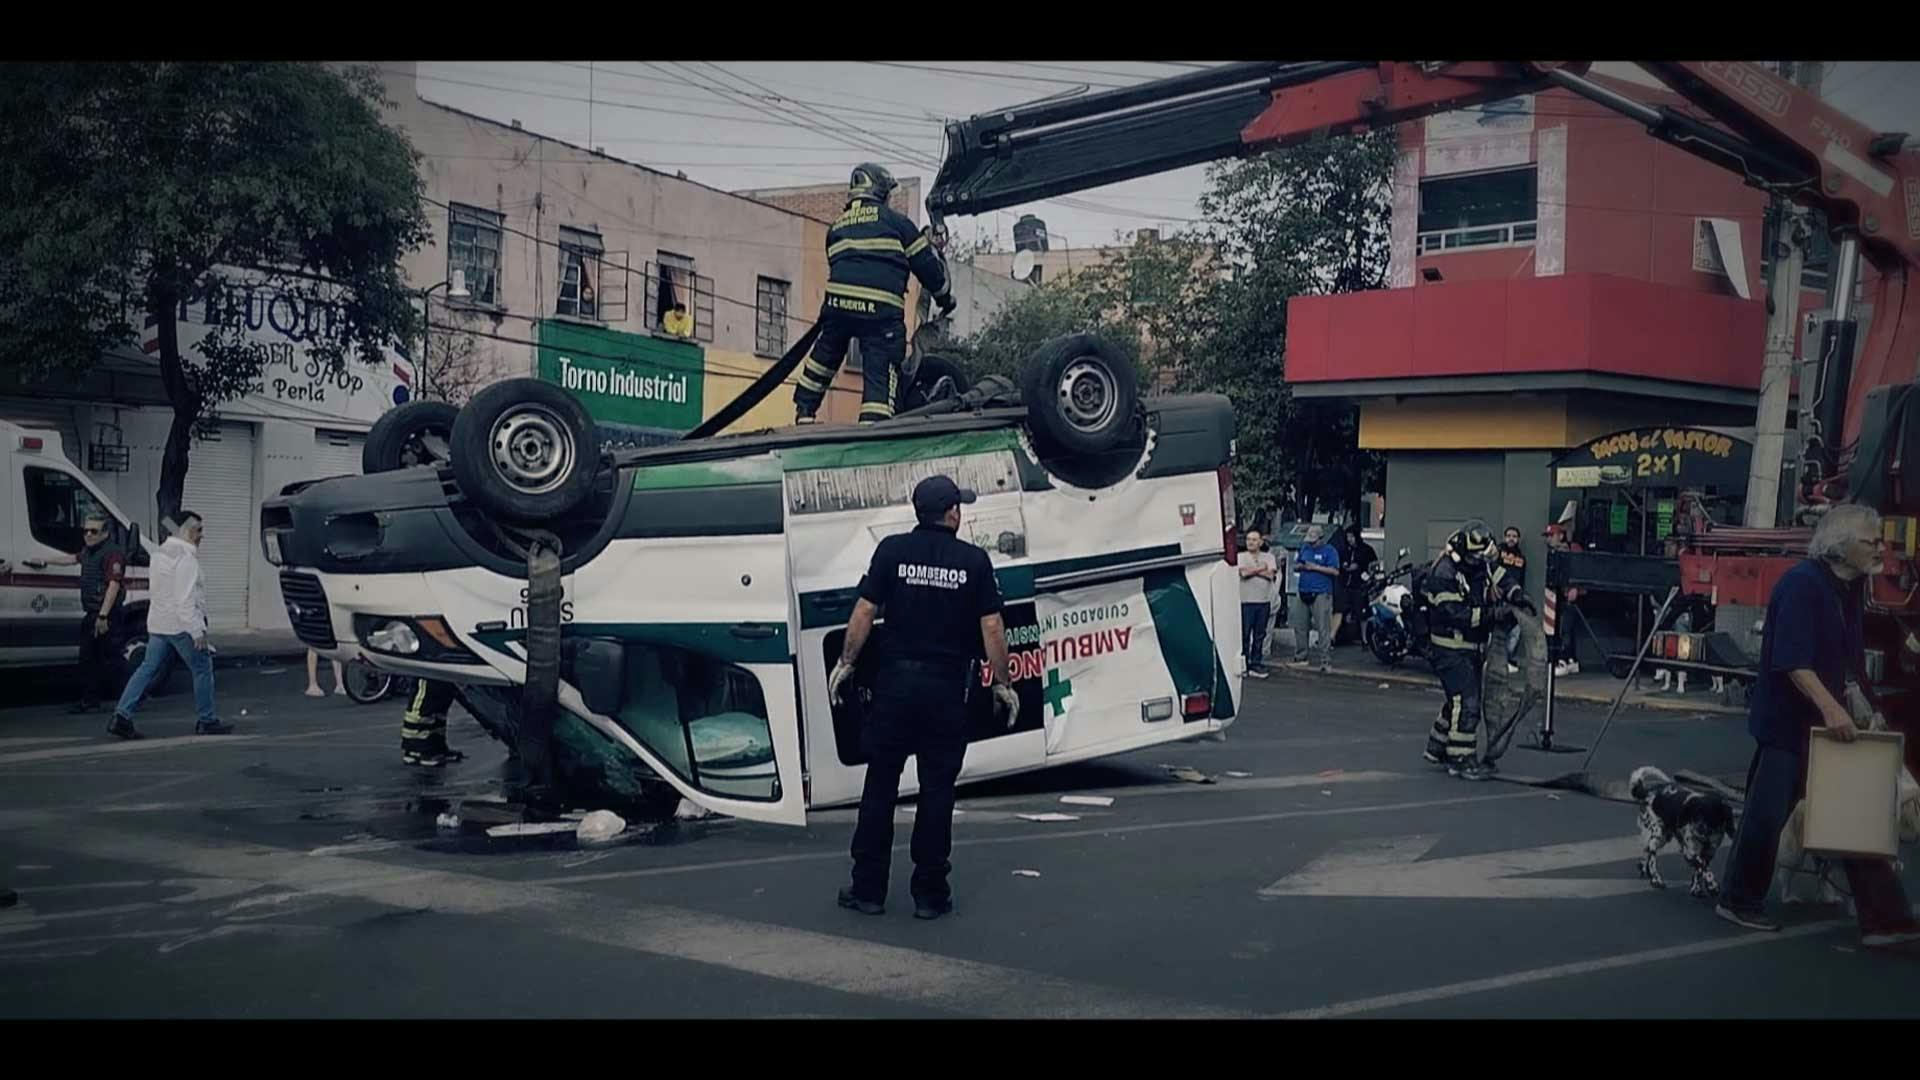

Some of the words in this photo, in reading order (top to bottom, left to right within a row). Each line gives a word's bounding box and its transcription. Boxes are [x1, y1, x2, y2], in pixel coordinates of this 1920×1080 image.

[272, 378, 326, 402] Perla
[559, 356, 607, 394] Torno
[610, 366, 687, 404] Industrial
[1591, 431, 1640, 460] TACOS
[898, 563, 968, 585] BOMBEROS
[1063, 604, 1129, 628] CUIDADOS
[978, 626, 1132, 688] AMBULANCA
